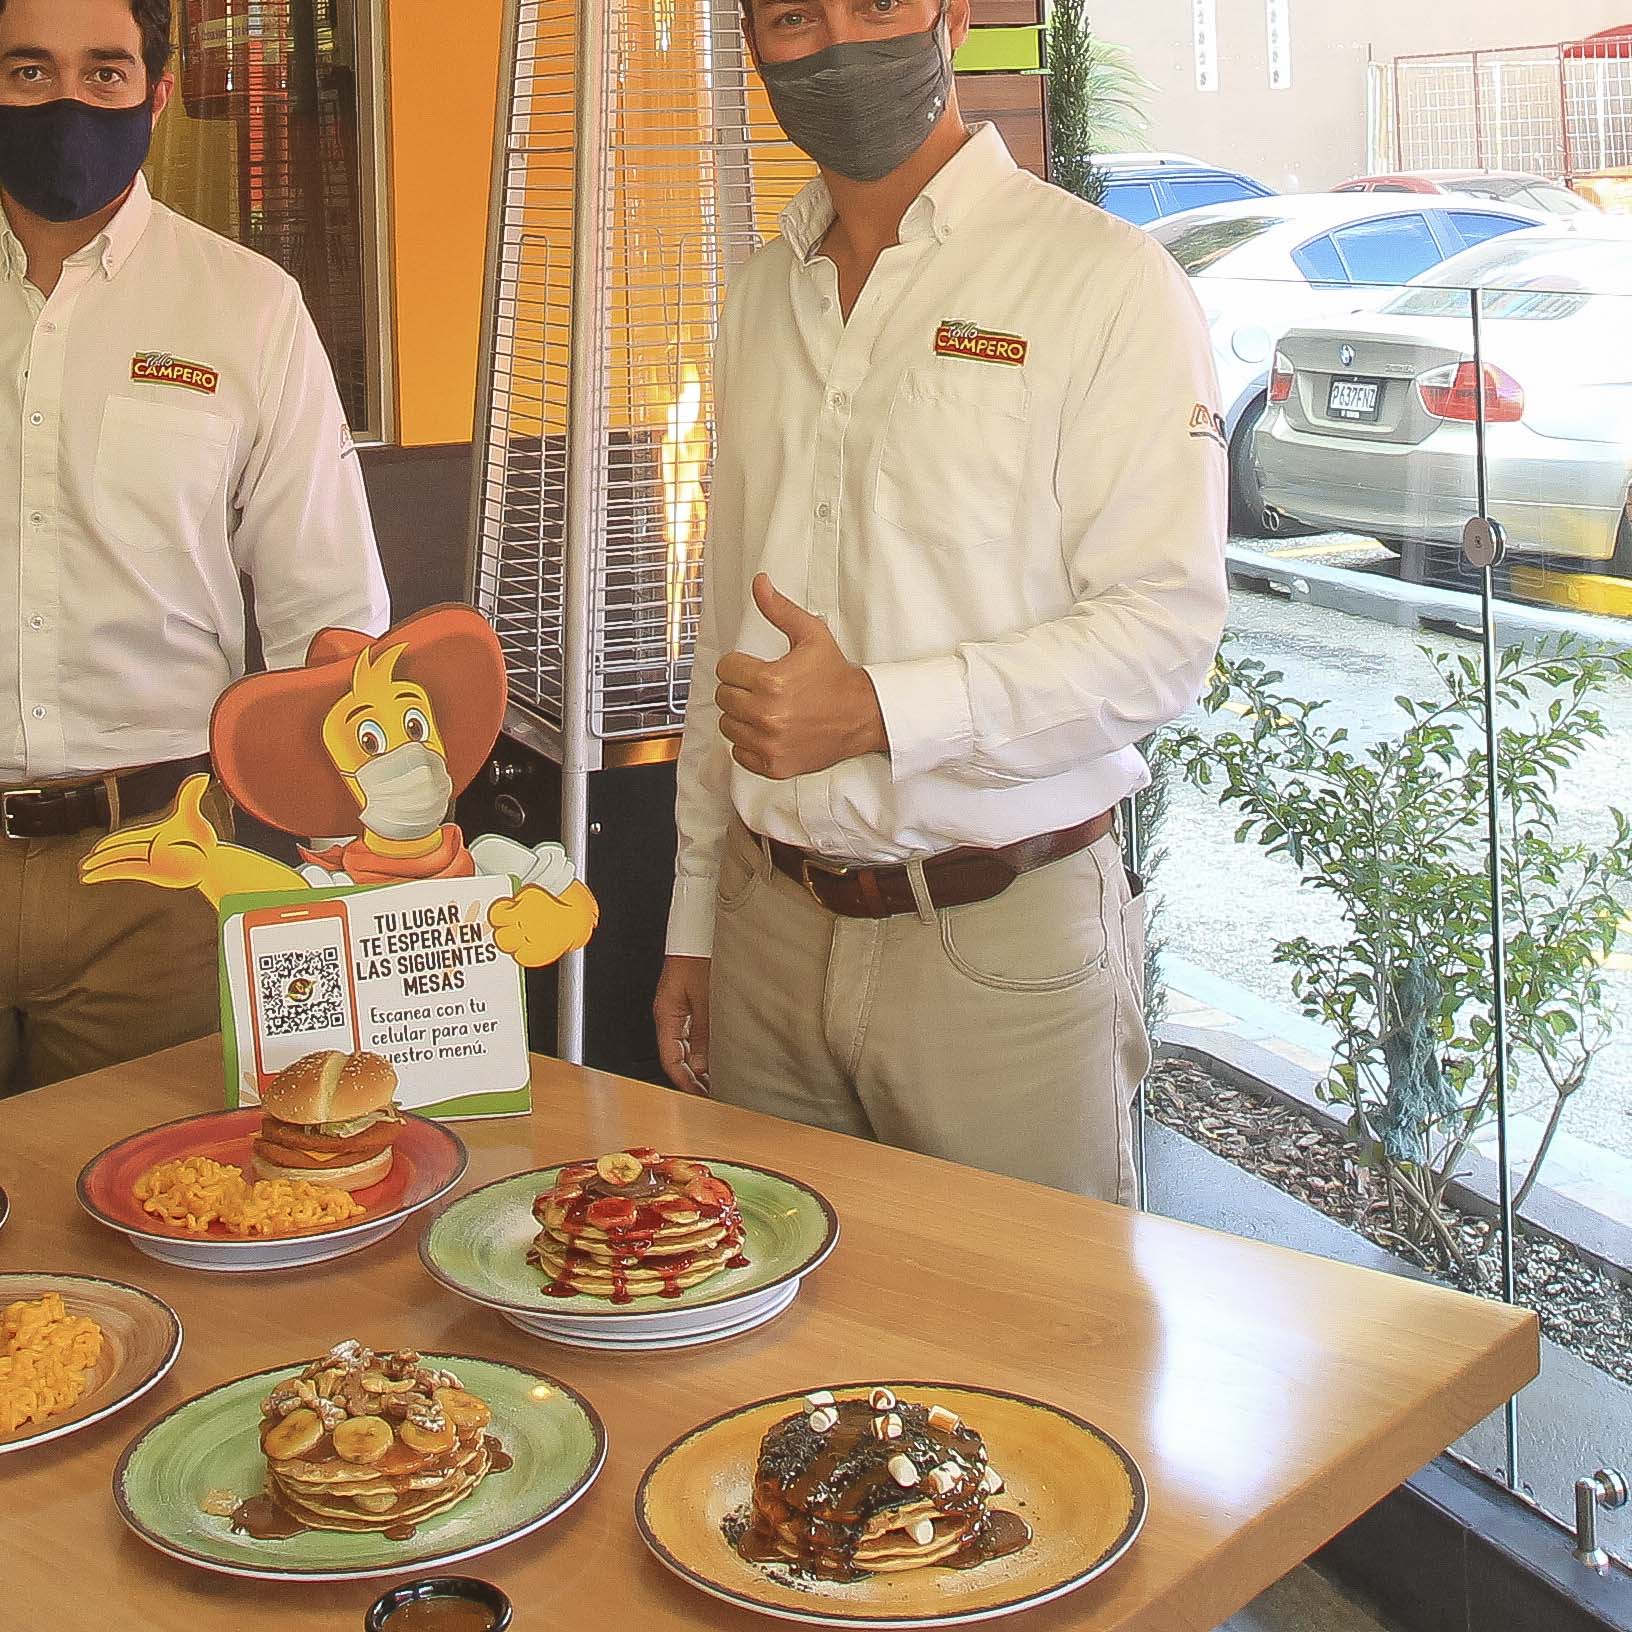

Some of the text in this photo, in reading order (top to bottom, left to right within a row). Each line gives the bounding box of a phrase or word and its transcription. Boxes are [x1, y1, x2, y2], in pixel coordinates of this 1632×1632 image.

[946, 319, 978, 338] Pollo
[937, 332, 1024, 359] CAMPERO
[145, 351, 174, 367] Pollo
[134, 362, 216, 388] CAMPERO
[374, 905, 460, 934] TU LUGAR
[359, 923, 483, 958] TE ESPERA EN
[356, 943, 497, 981] LAS SIGUIENTES
[403, 970, 465, 996] MESAS
[370, 998, 486, 1024] Escanea con tu
[372, 1021, 498, 1046] celular para ver
[384, 1040, 487, 1064] uestro menú.
